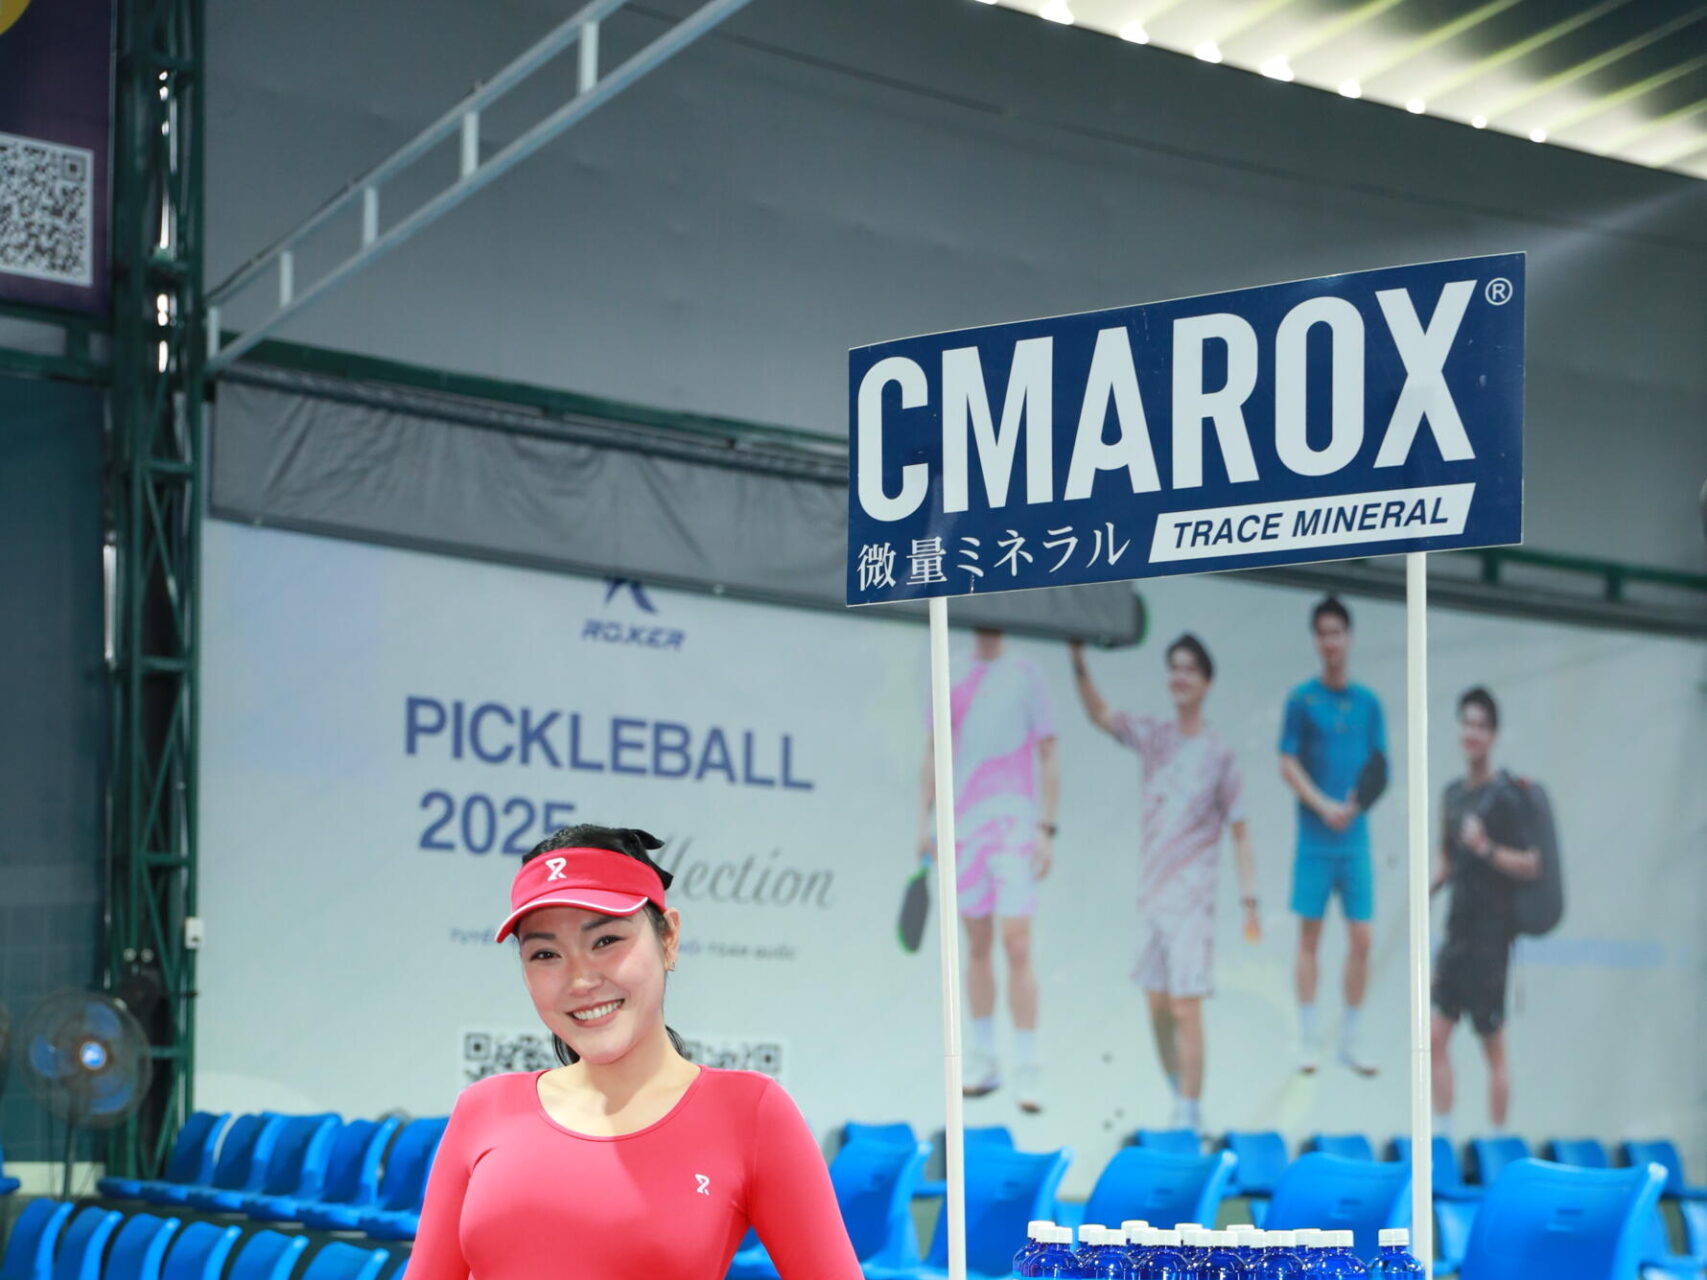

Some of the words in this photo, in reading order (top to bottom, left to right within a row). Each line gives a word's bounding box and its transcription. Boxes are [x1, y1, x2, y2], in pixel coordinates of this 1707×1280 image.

[857, 279, 1478, 523] CMAROX
[856, 521, 1132, 593] 微量ミネラル
[1172, 513, 1281, 551] TRACE
[1291, 498, 1450, 540] MINERAL
[404, 694, 815, 792] PICKLEBALL
